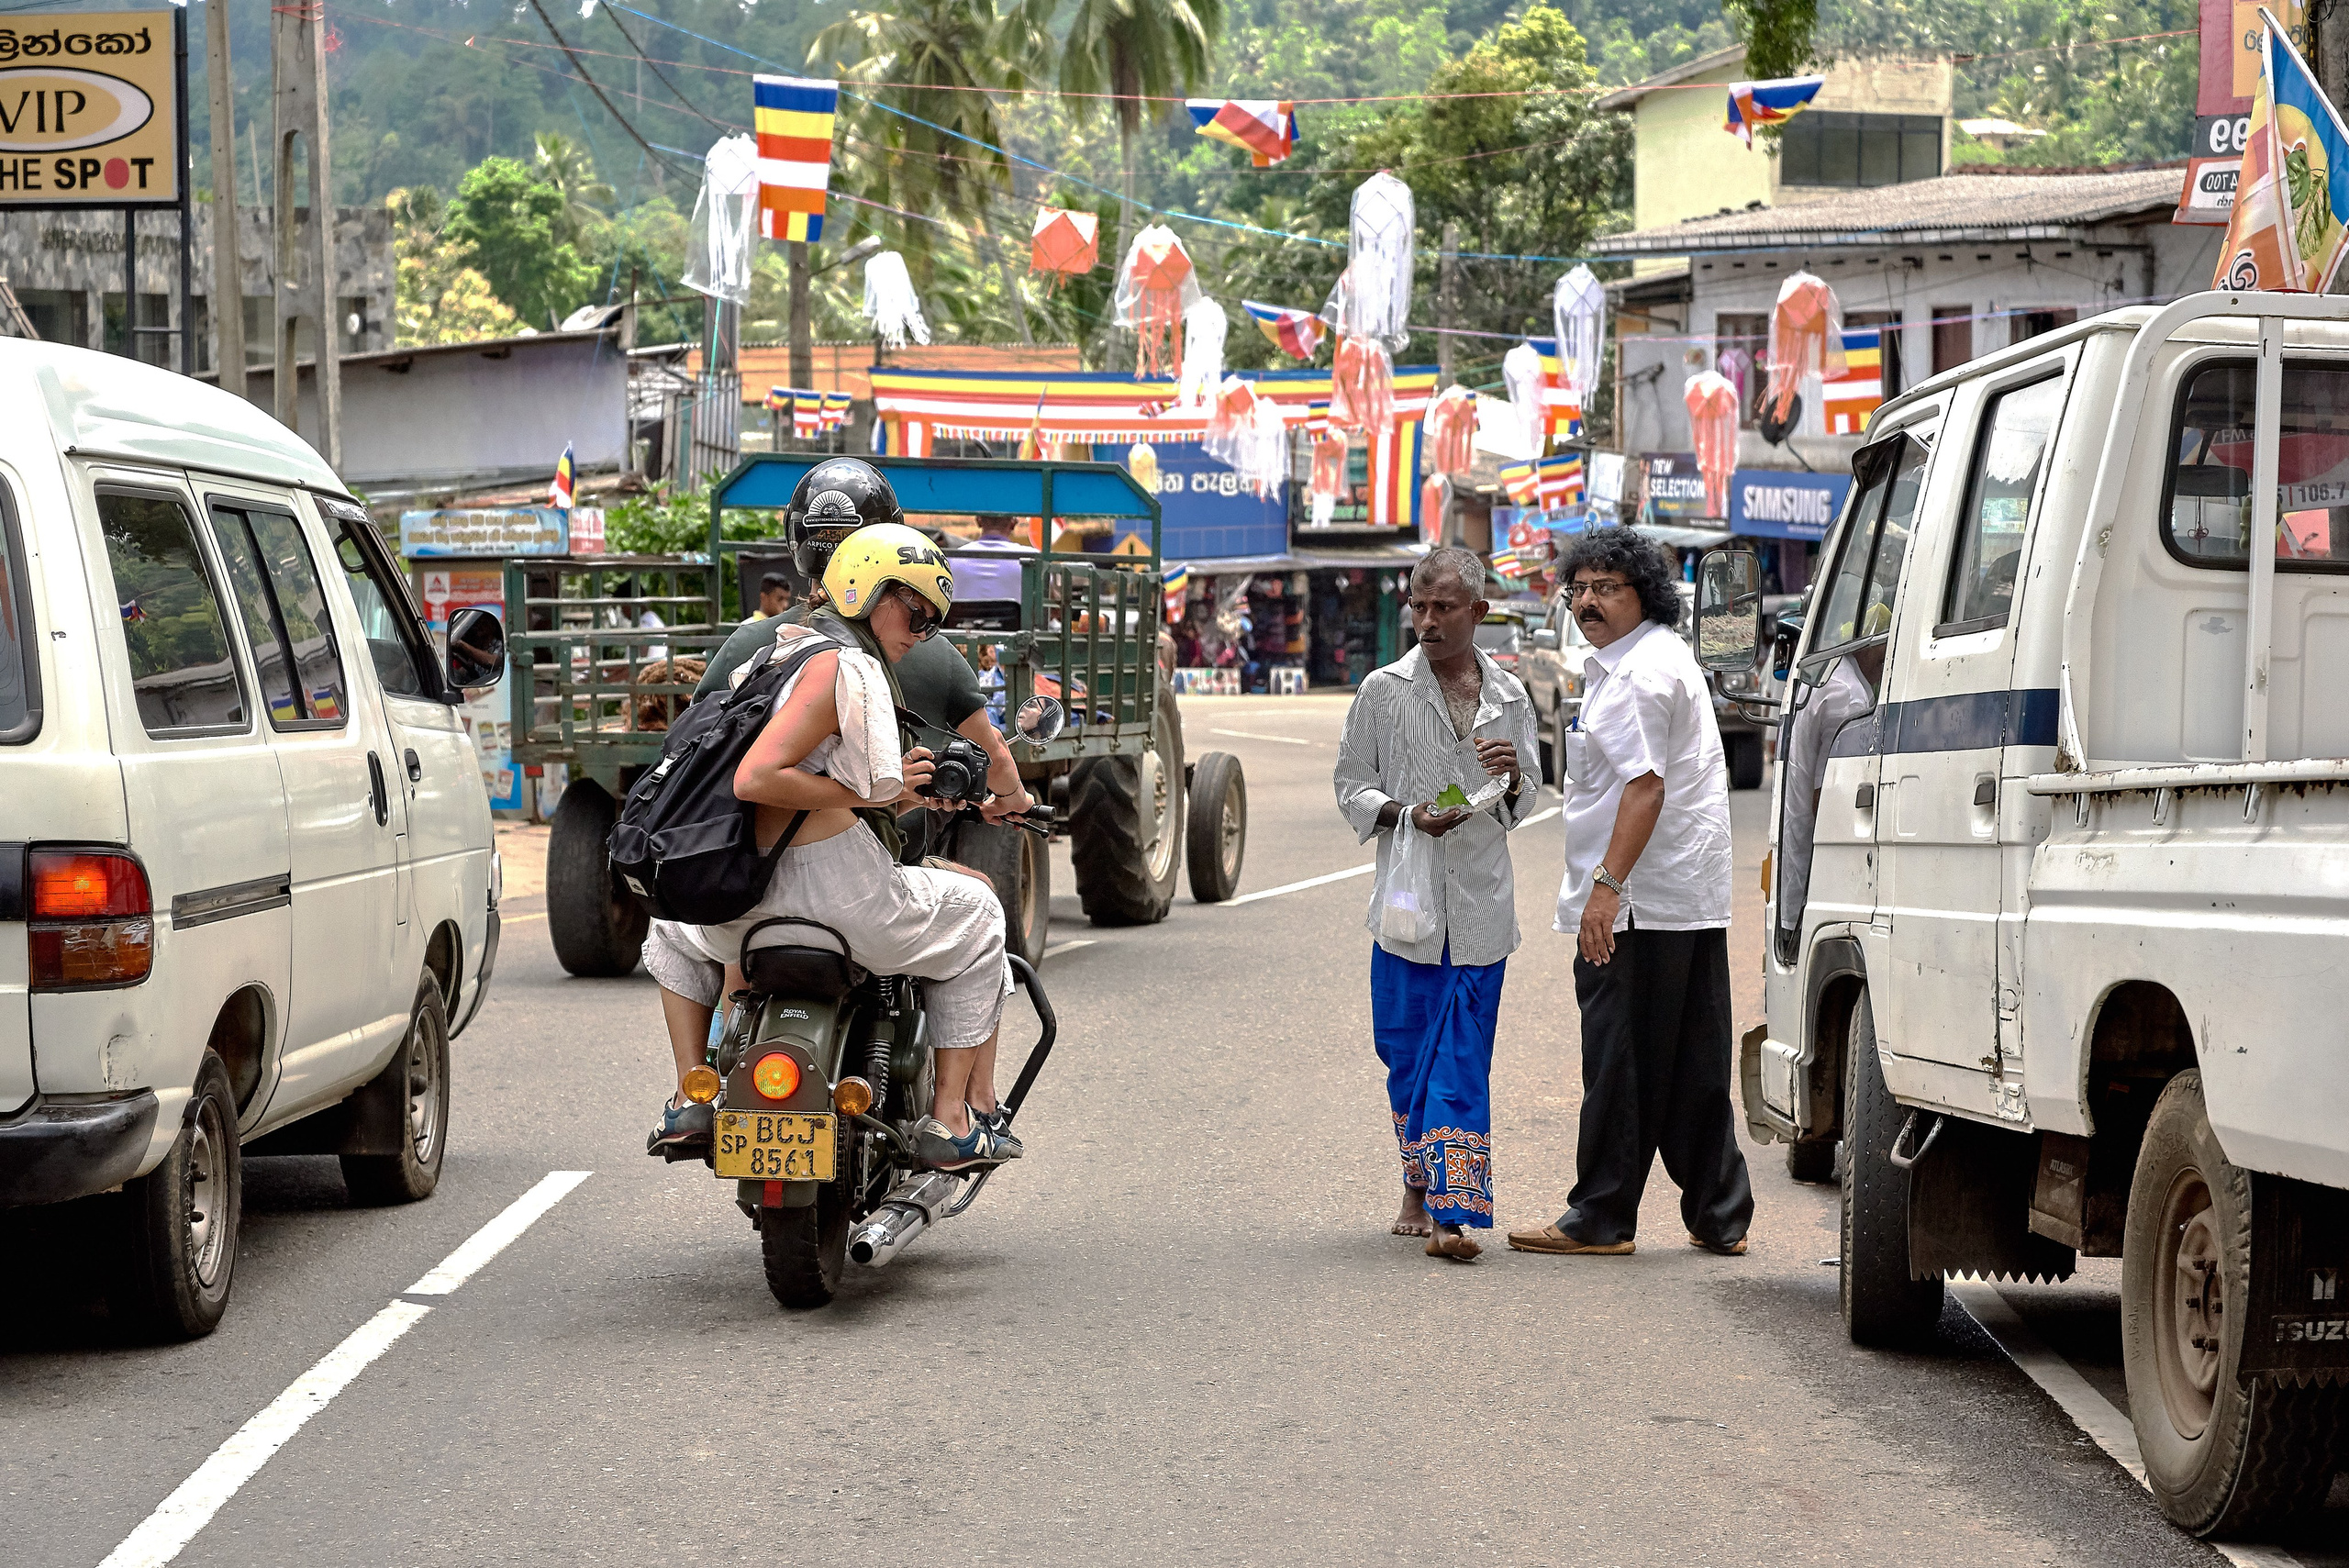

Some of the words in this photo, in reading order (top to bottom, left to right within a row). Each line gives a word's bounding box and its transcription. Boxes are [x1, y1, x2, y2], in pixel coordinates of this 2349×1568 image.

[0, 90, 86, 134] VIP
[54, 157, 154, 191] SPOT
[1650, 477, 1707, 498] SELECTION
[2299, 480, 2346, 503] 106.7
[1742, 484, 1832, 526] SAMSUNG
[807, 539, 833, 549] ARPICO
[756, 1116, 815, 1144] BCJ
[720, 1134, 748, 1154] SP
[751, 1147, 816, 1176] 8561
[2277, 1320, 2349, 1342] ISUZ
